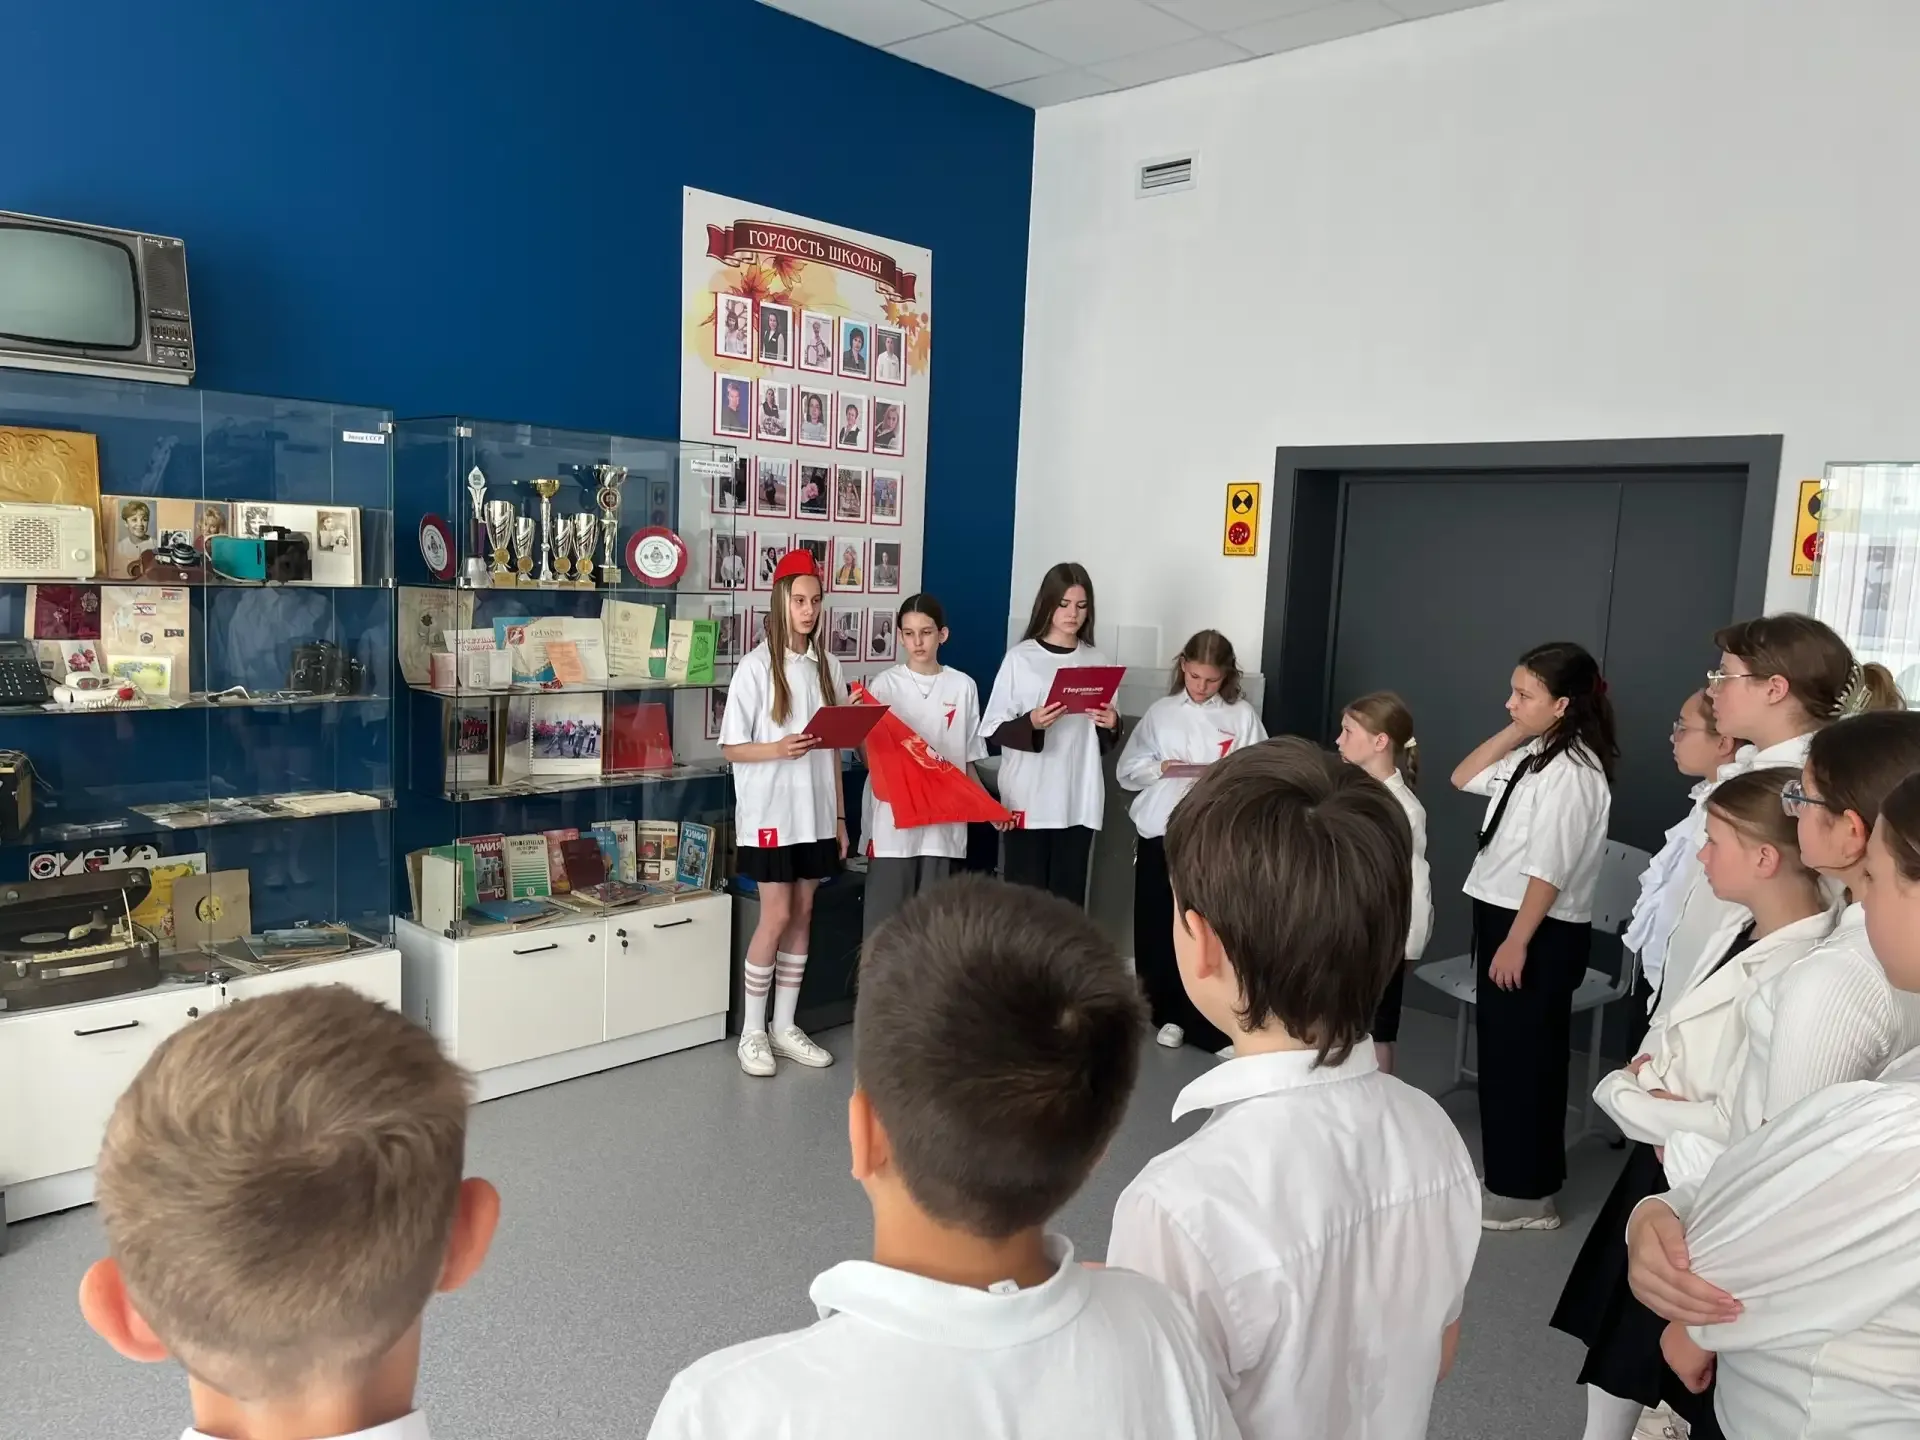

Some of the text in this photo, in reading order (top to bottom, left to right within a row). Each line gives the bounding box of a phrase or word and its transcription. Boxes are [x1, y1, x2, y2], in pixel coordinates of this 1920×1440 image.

[749, 230, 882, 274] ГОРДОСТЬ ШКОЛЫ
[684, 828, 707, 841] ХИМИЯ
[473, 841, 501, 853] ИМИЯ
[664, 868, 671, 876] 5
[494, 887, 505, 898] 10
